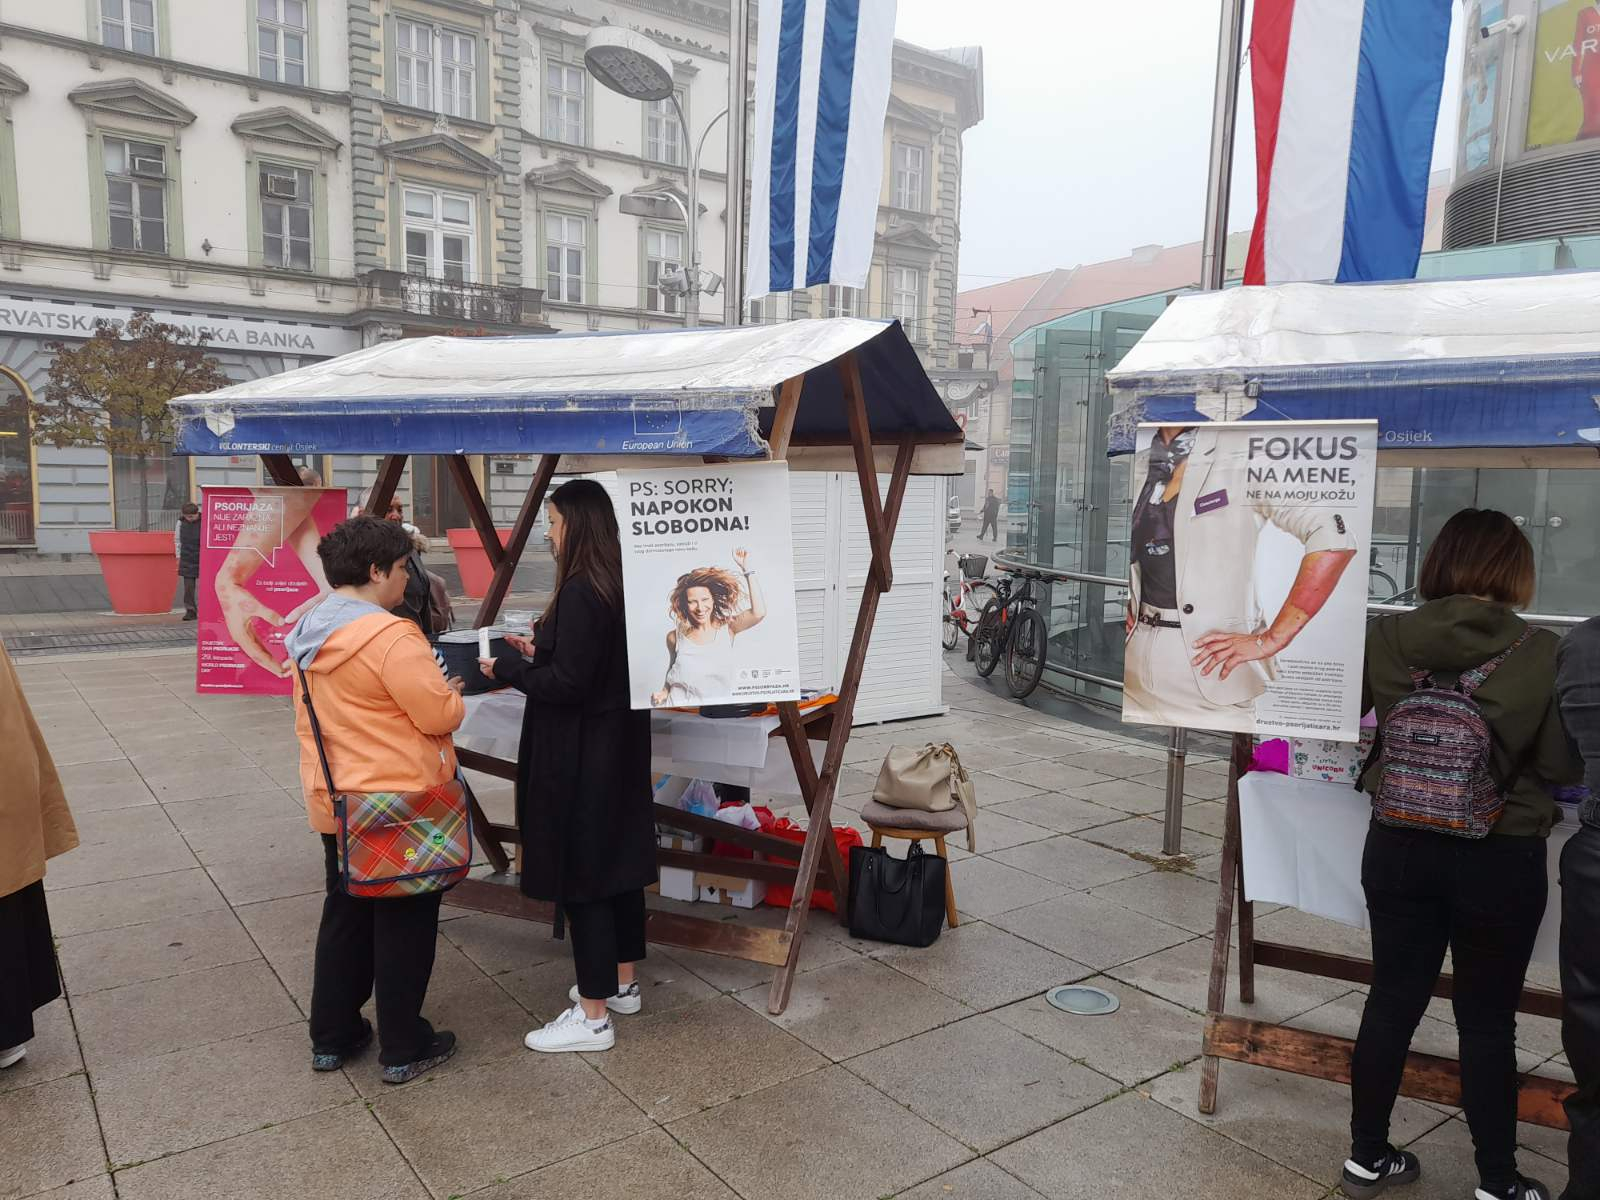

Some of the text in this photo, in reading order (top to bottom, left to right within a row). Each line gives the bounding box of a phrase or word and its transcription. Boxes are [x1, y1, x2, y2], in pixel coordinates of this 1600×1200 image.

[246, 330, 315, 349] BANKA
[1385, 430, 1433, 444] Osijek
[622, 439, 693, 450] European Union
[1248, 436, 1358, 461] FOKUS
[1247, 467, 1356, 487] NA MENE,
[630, 477, 734, 497] PS: SORRY;
[1246, 489, 1356, 500] NE NA MOJU KOŽU
[214, 502, 273, 512] PSORIJAZA
[631, 497, 733, 517] NAPOKON
[213, 513, 230, 521] NIJE
[213, 523, 225, 531] ALI
[632, 515, 750, 536] SLOBODNA!
[1312, 764, 1344, 773] UNICORN
